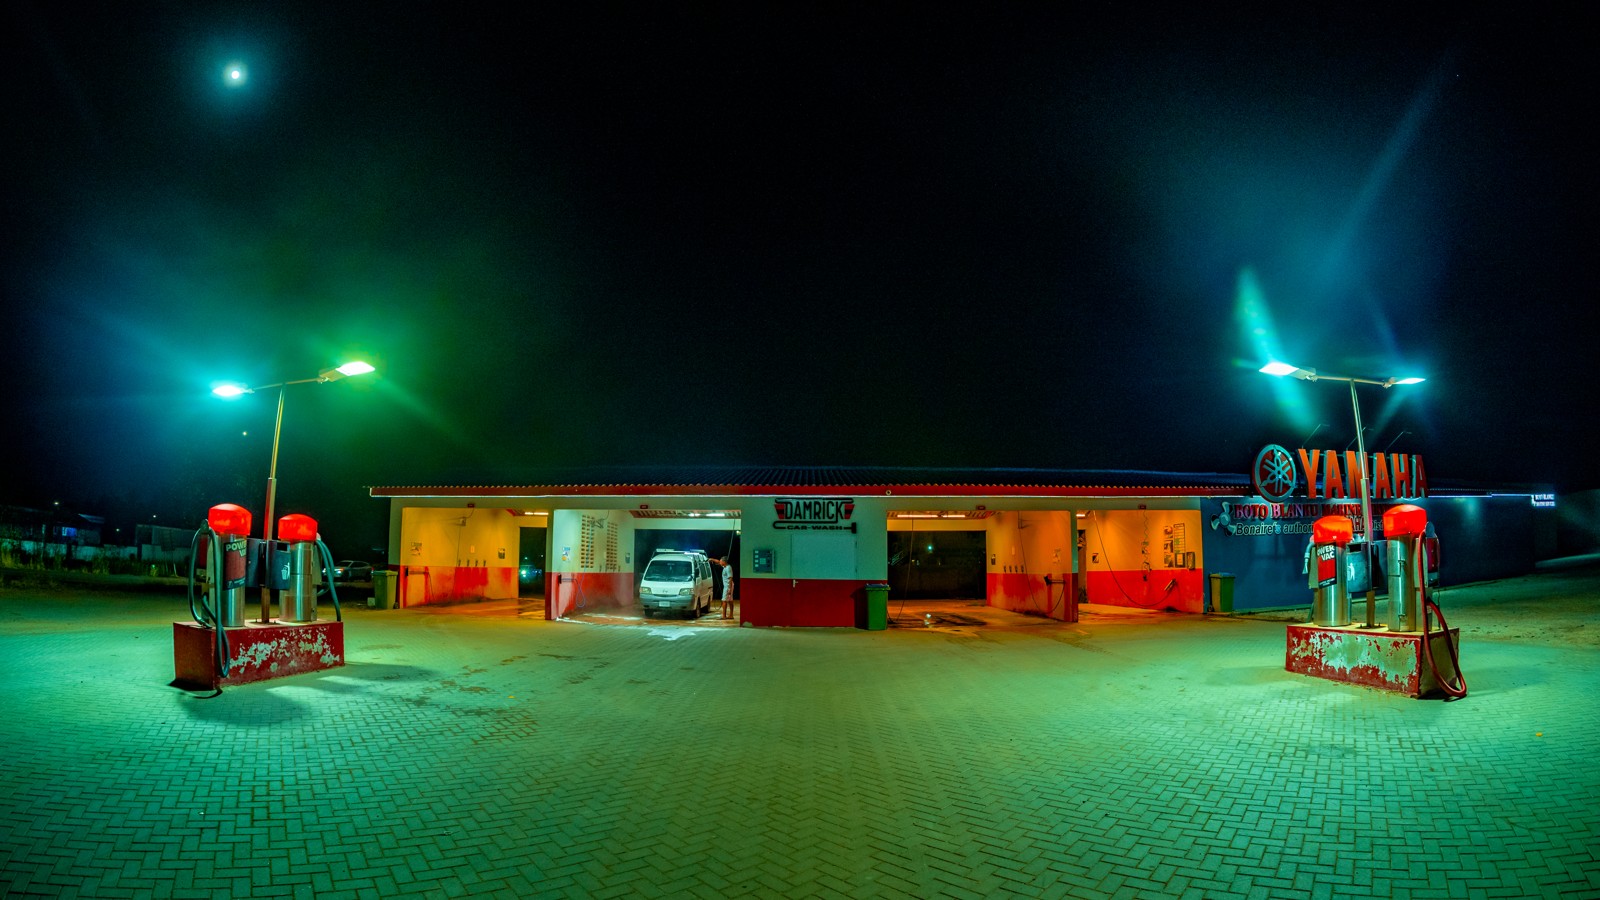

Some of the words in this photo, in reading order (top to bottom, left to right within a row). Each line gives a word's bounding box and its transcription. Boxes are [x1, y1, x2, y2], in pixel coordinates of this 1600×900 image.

[1297, 448, 1428, 499] YAMAHA
[784, 500, 845, 520] DAMRICK
[1234, 503, 1270, 519] BOTO
[1235, 522, 1282, 536] Bonaire's
[1317, 545, 1335, 556] OWER
[1321, 551, 1335, 561] VAC
